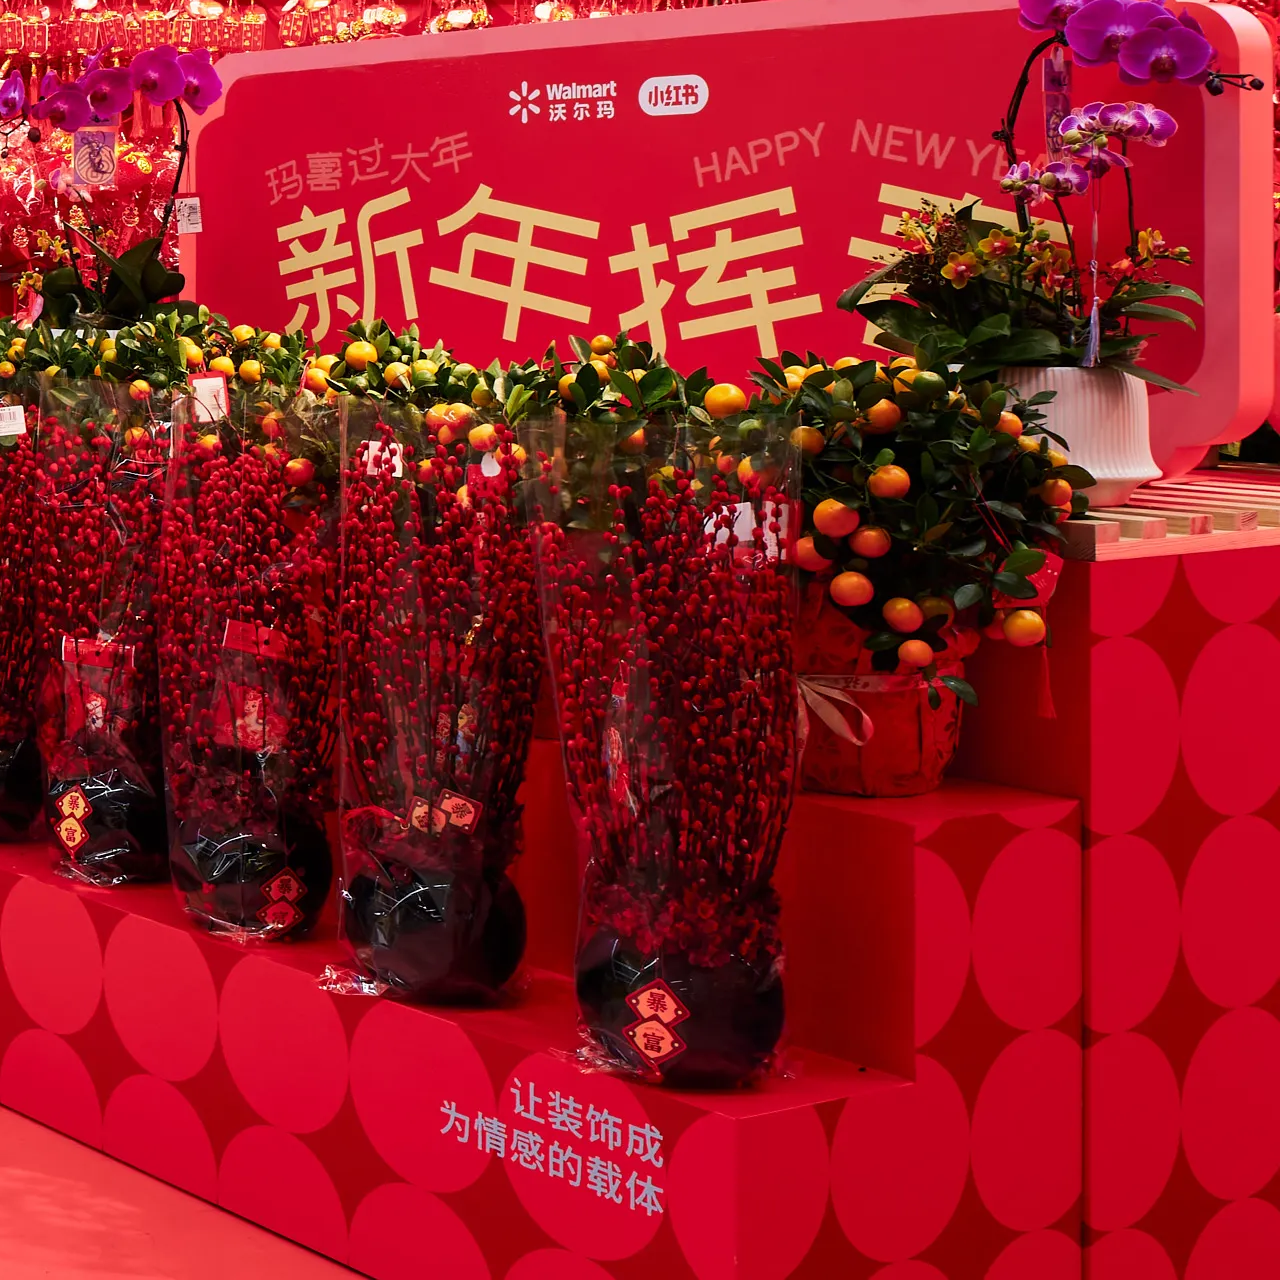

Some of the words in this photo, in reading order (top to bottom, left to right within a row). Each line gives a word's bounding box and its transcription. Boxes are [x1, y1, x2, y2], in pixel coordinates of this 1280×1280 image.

[547, 80, 617, 101] Walmart
[549, 101, 615, 123] 沃尔玛
[648, 83, 700, 108] 小红书
[265, 131, 473, 206] 玛薯过大年
[693, 121, 827, 188] HAPPY
[851, 119, 956, 170] NEW
[510, 1077, 664, 1169] 让装饰成
[440, 1099, 665, 1217] 为情感的载体
